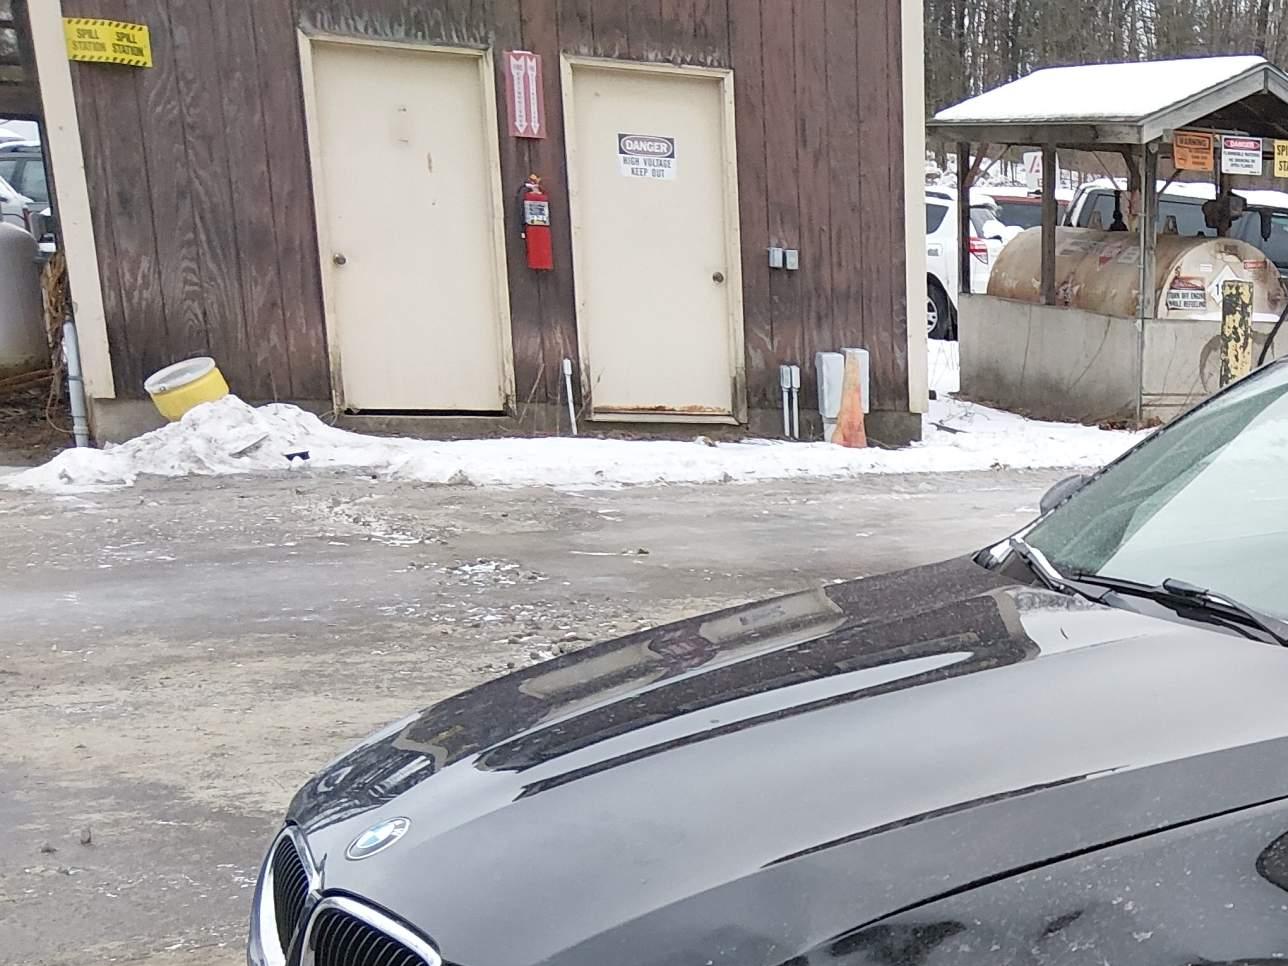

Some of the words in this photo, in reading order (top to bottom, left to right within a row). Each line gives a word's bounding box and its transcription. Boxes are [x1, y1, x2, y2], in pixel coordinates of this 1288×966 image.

[76, 28, 100, 40] SPILL
[115, 31, 138, 44] SPILL
[72, 40, 107, 52] STATION
[111, 43, 145, 57] STATION
[625, 140, 668, 152] DANGER
[623, 157, 640, 165] HIGH
[643, 158, 671, 168] VOLTAGE
[631, 167, 648, 177] KEEP
[652, 169, 664, 177] OUT
